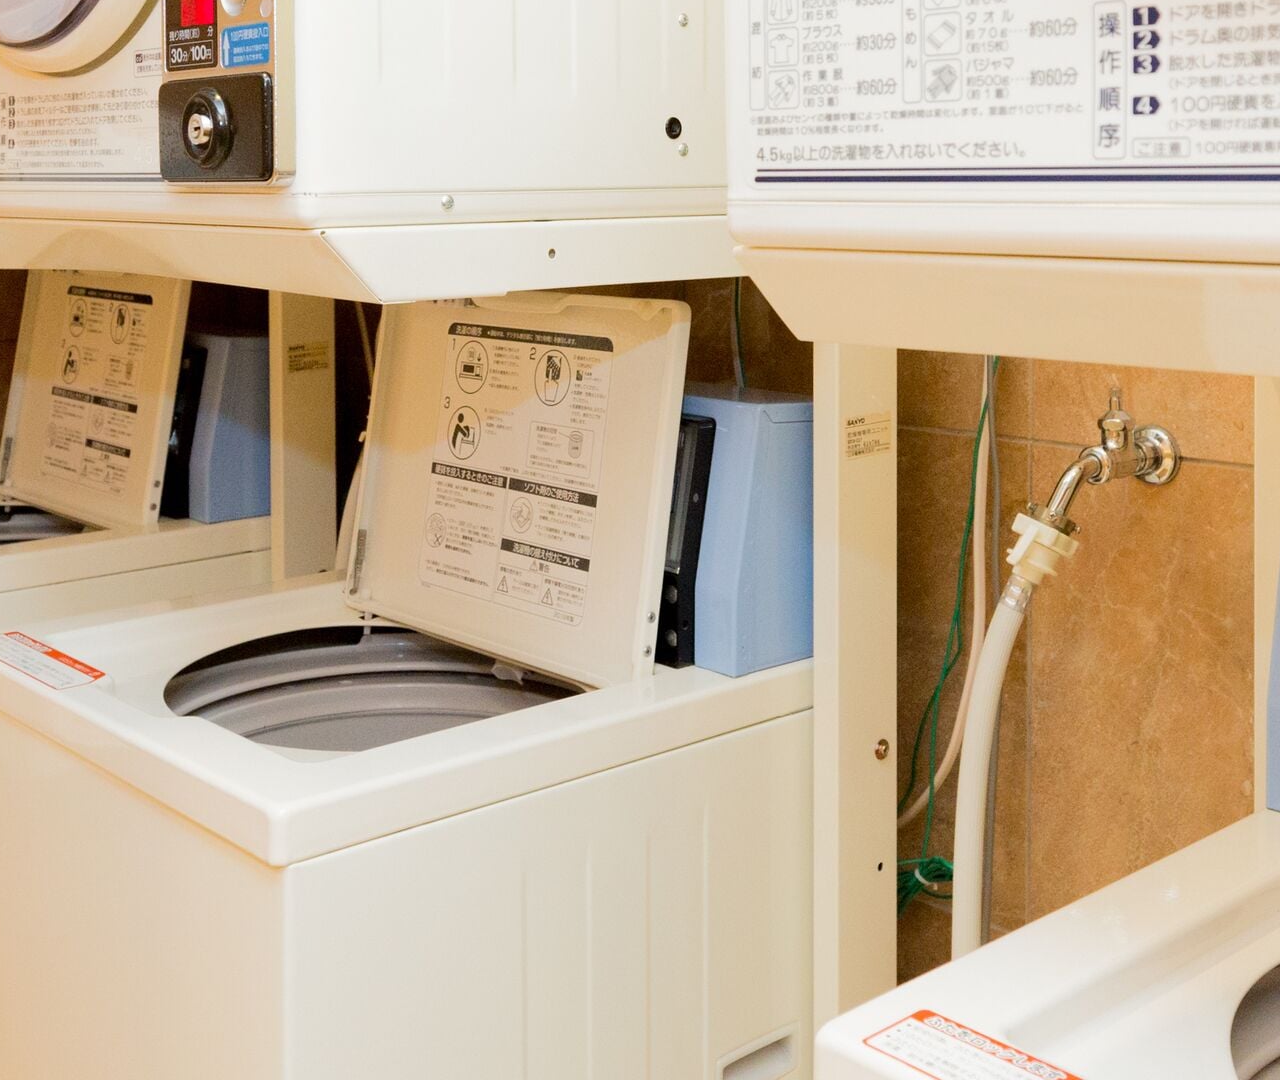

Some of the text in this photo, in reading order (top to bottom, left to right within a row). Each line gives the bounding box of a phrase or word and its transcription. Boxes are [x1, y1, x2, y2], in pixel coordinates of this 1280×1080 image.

[1028, 18, 1078, 38] 約60分
[1029, 68, 1078, 87] 約60分
[756, 142, 1027, 163] 4.5kg以上の洗濯物を入れないでください。
[529, 347, 537, 361] 2
[443, 396, 451, 409] 3
